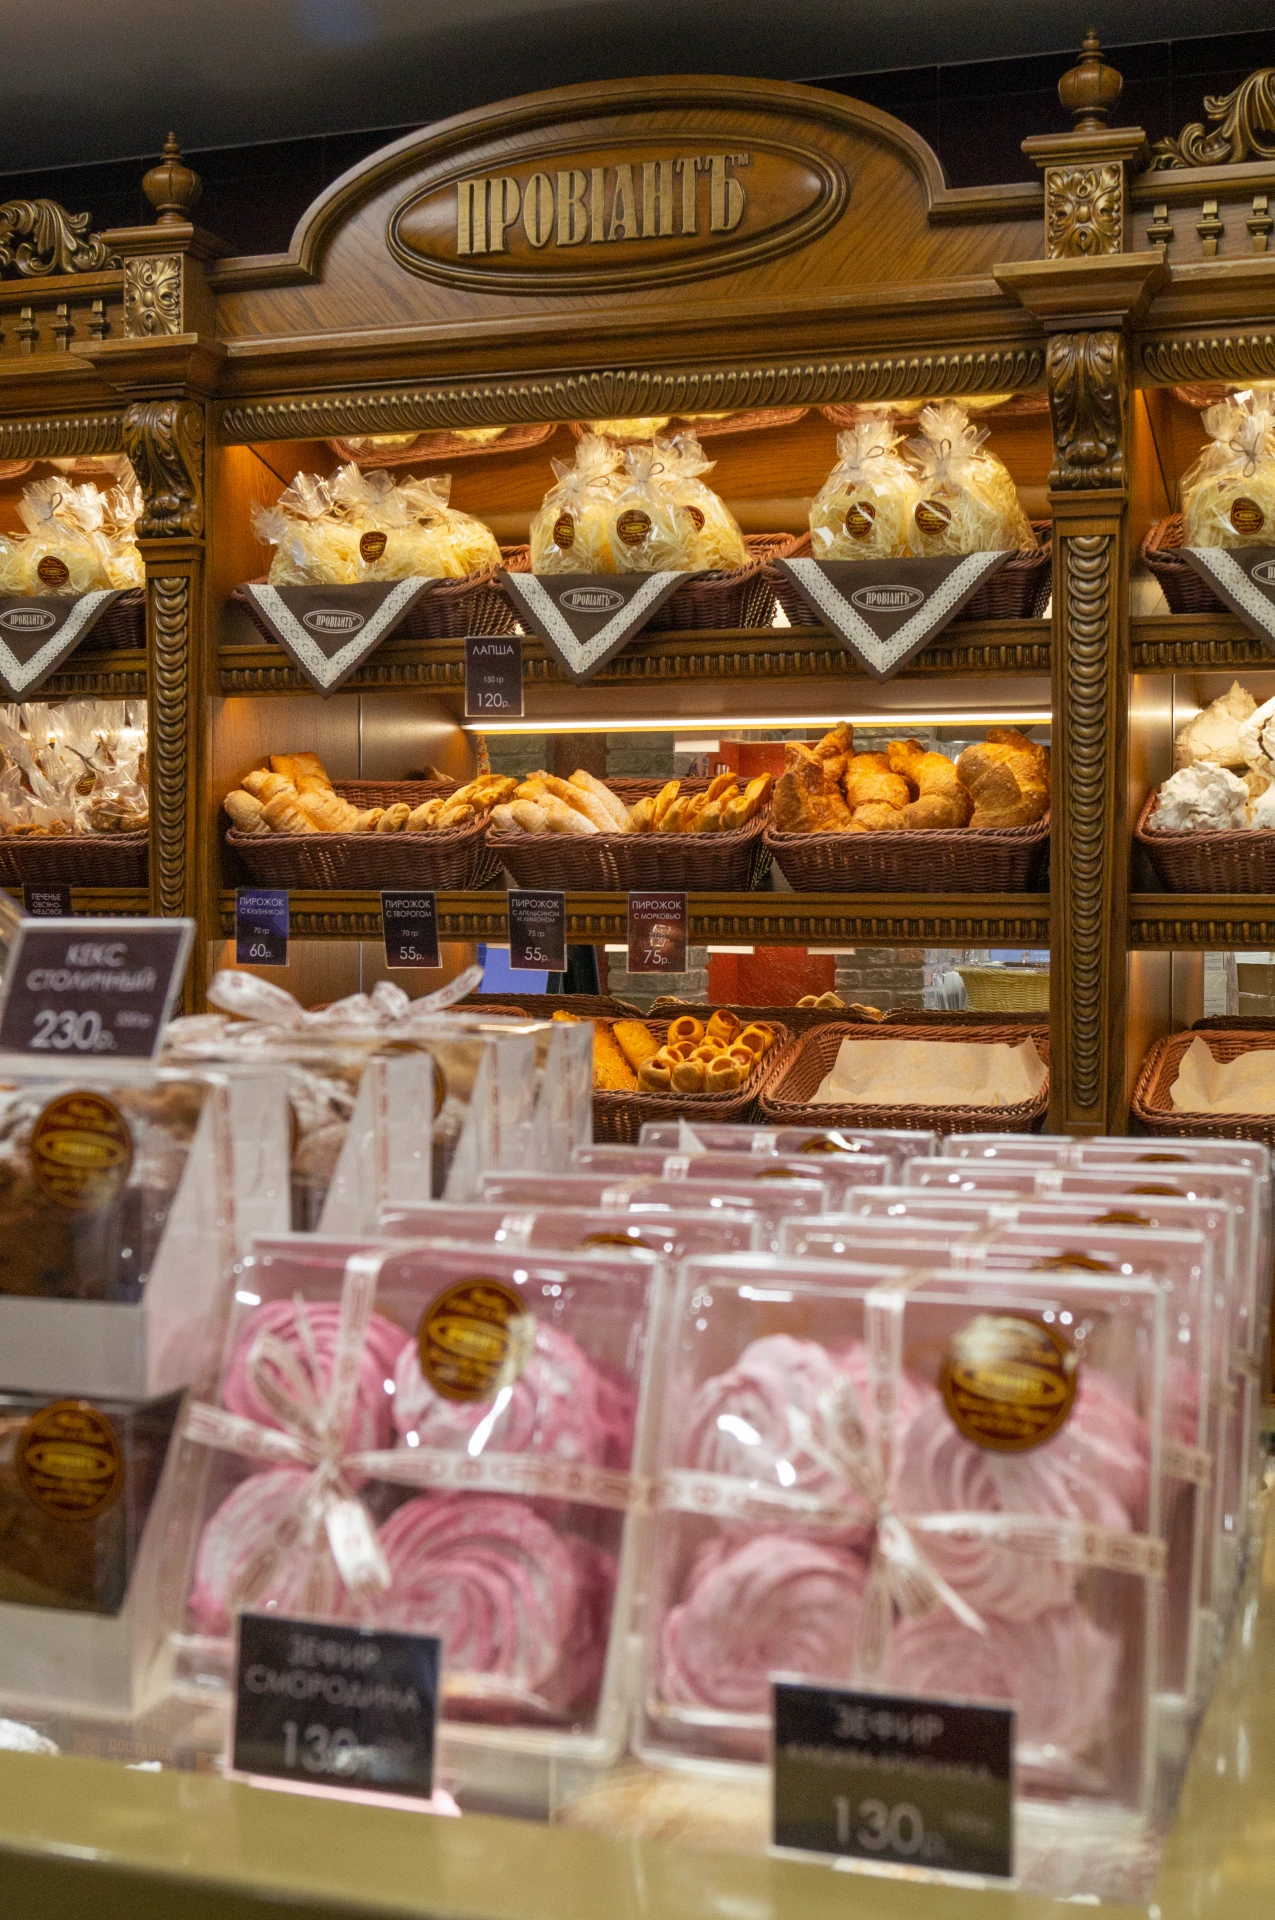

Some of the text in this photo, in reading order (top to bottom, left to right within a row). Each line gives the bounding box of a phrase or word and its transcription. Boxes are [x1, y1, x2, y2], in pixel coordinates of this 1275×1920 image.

[457, 154, 746, 255] ПРОВІАНТЪ
[472, 645, 514, 655] ЛАПША
[496, 676, 504, 684] гр
[31, 893, 62, 901] ПЕЧЕНЬЕ
[239, 897, 284, 907] ПИРОЖОК
[385, 900, 431, 909] ПИРОЖОК
[511, 899, 560, 909] ПИРОЖОК
[631, 900, 682, 910] ПИРОЖОК
[32, 908, 62, 916] МЕДОВОЕ
[246, 908, 285, 916] КЛУБНИКОЙ
[640, 912, 681, 920] МОРКОВЬЮ
[253, 926, 262, 934] 70
